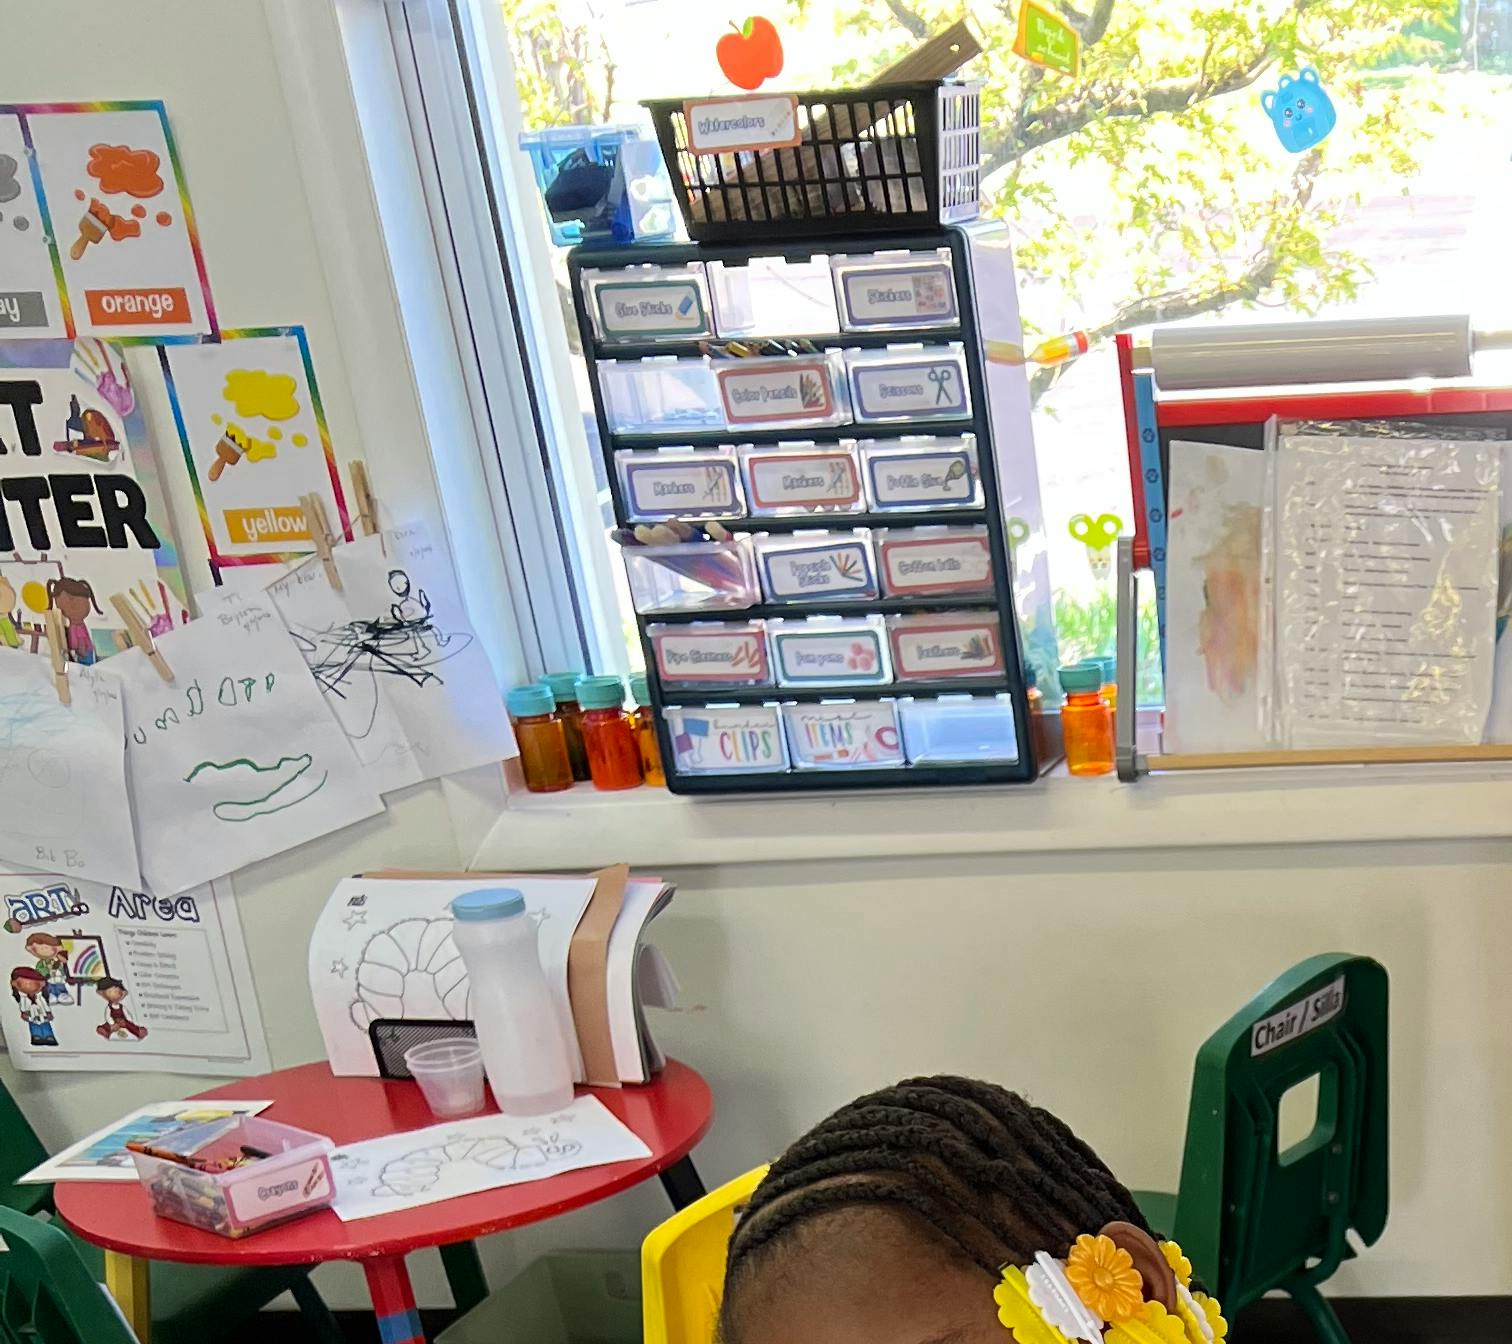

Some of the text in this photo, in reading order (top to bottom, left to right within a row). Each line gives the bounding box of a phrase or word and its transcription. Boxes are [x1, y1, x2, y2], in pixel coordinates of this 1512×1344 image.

[101, 289, 174, 319] orange
[0, 379, 43, 456] T
[241, 508, 308, 541] yellow
[719, 729, 774, 763] CLIPS
[805, 721, 853, 749] ITEMS
[108, 885, 201, 923] Area
[1255, 1011, 1298, 1050] Chair
